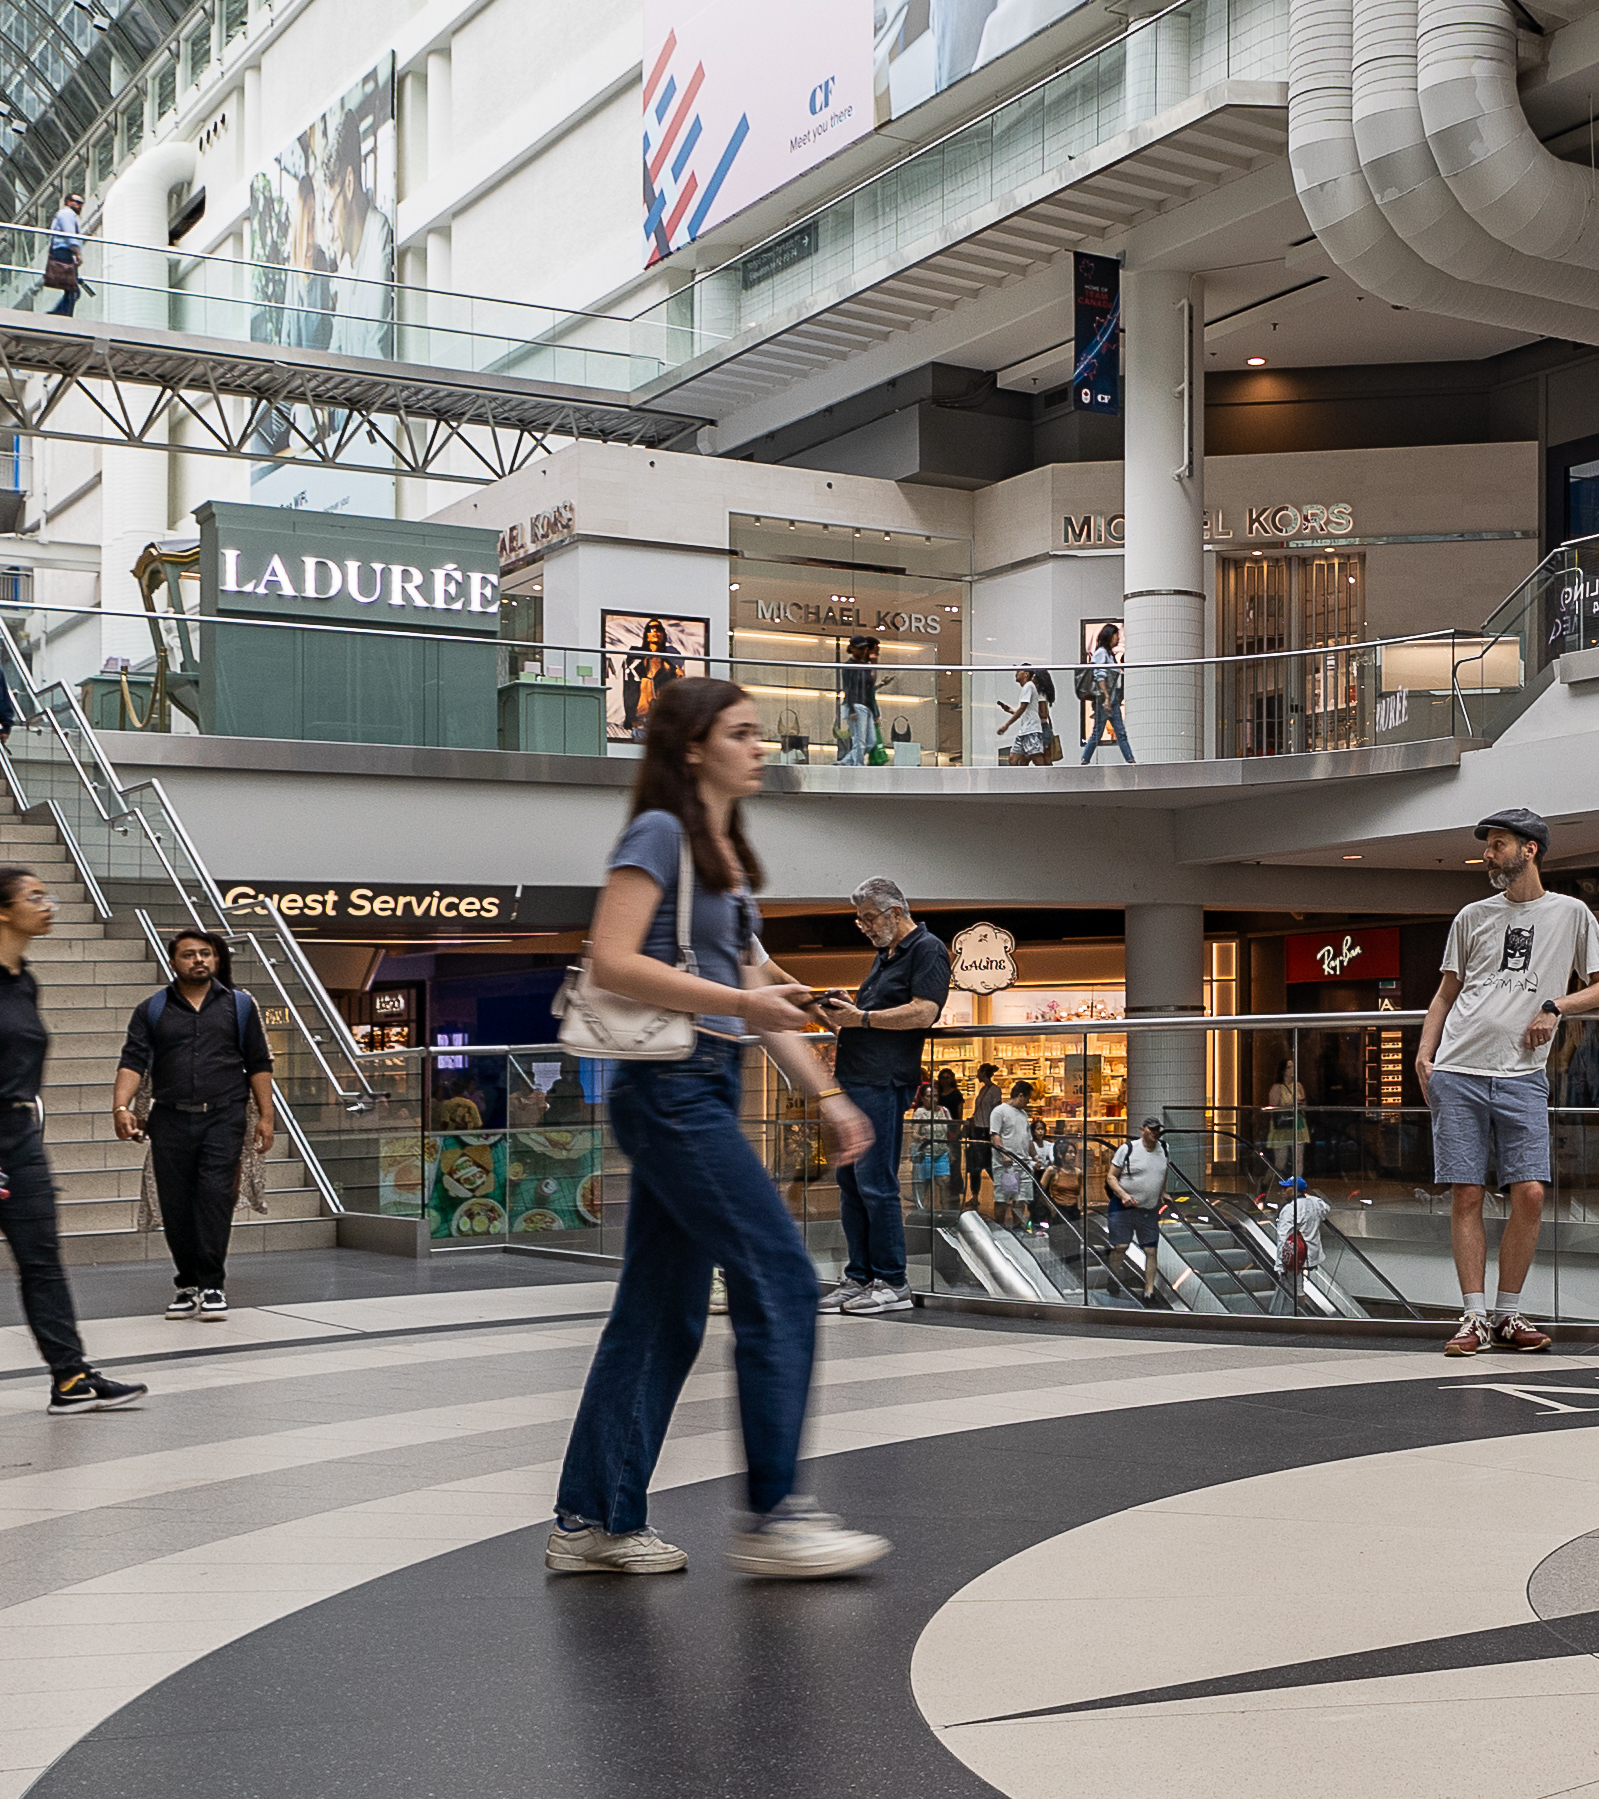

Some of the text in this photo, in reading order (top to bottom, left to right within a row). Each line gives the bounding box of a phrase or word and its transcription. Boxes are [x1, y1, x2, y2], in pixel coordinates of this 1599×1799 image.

[809, 75, 836, 116] CF
[789, 104, 854, 154] Meet you there
[1077, 297, 1113, 310] CANADA
[1084, 284, 1100, 292] HOME
[1085, 290, 1108, 300] TEAM
[498, 499, 575, 558] AEL KORS
[1062, 502, 1354, 545] MICL KORS
[219, 547, 499, 613] LADURÉE
[756, 599, 941, 635] MICHAEL KORS
[225, 886, 500, 918] Guest Services
